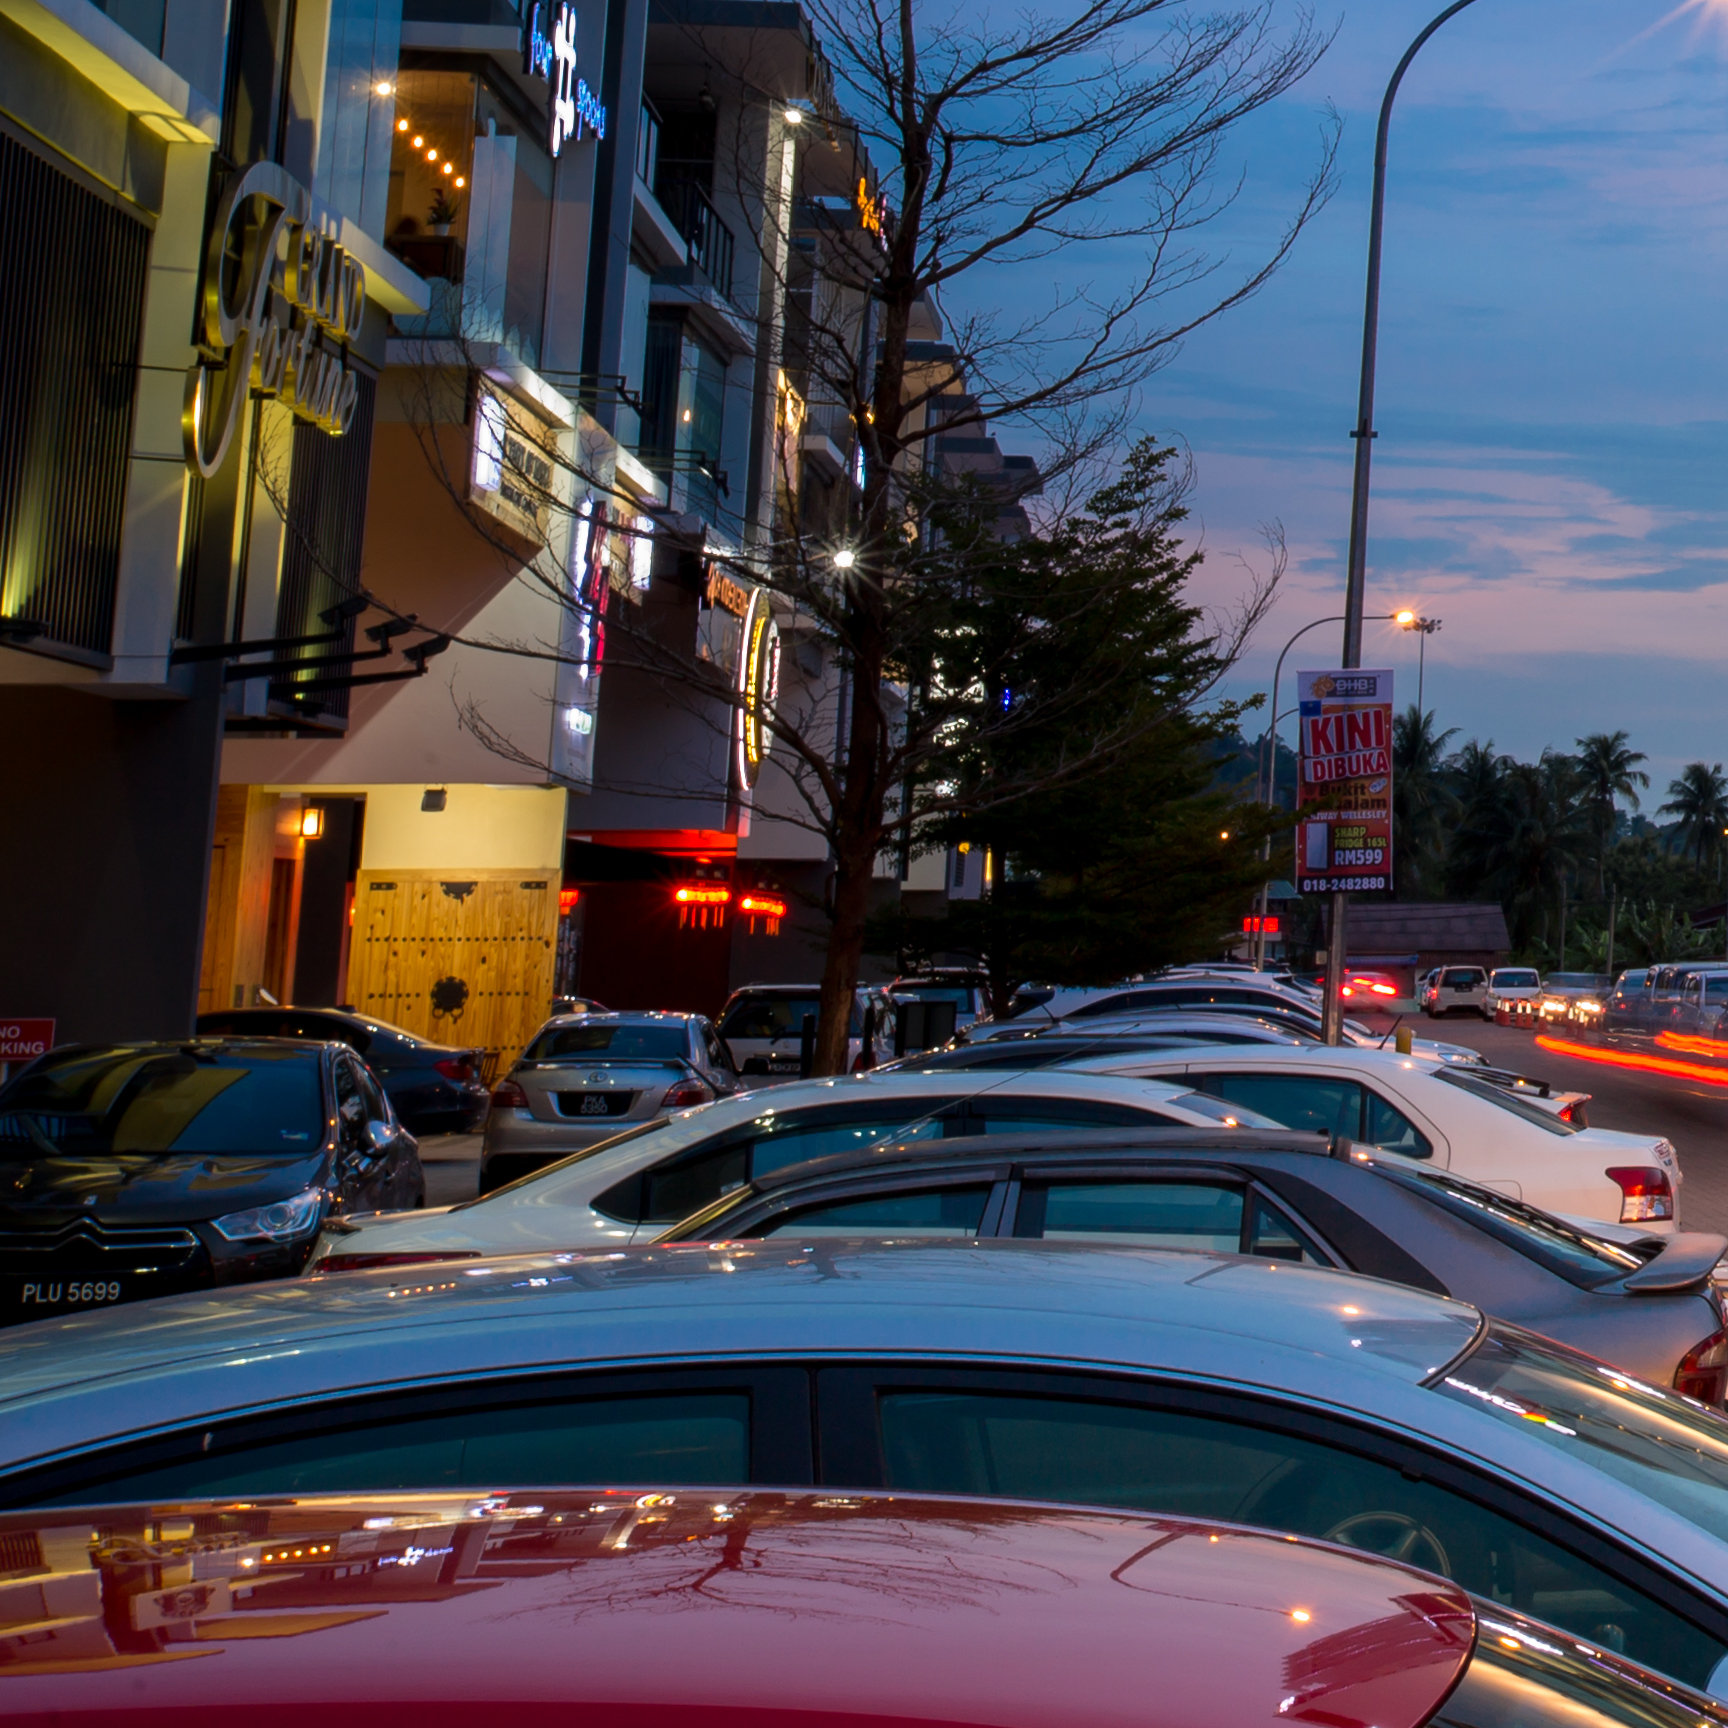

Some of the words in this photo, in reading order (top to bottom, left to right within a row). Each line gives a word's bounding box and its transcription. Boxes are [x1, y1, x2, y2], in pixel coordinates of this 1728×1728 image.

[1310, 709, 1385, 758] KINI
[1312, 751, 1389, 782] DIBUKA
[1335, 827, 1366, 838] SHARP
[1335, 837, 1364, 848] FRIDGE
[1335, 849, 1383, 865] RM599
[1303, 877, 1385, 891] 018-2482880
[0, 1041, 45, 1054] KING
[22, 1282, 63, 1304] PLU
[66, 1281, 121, 1302] 5699
